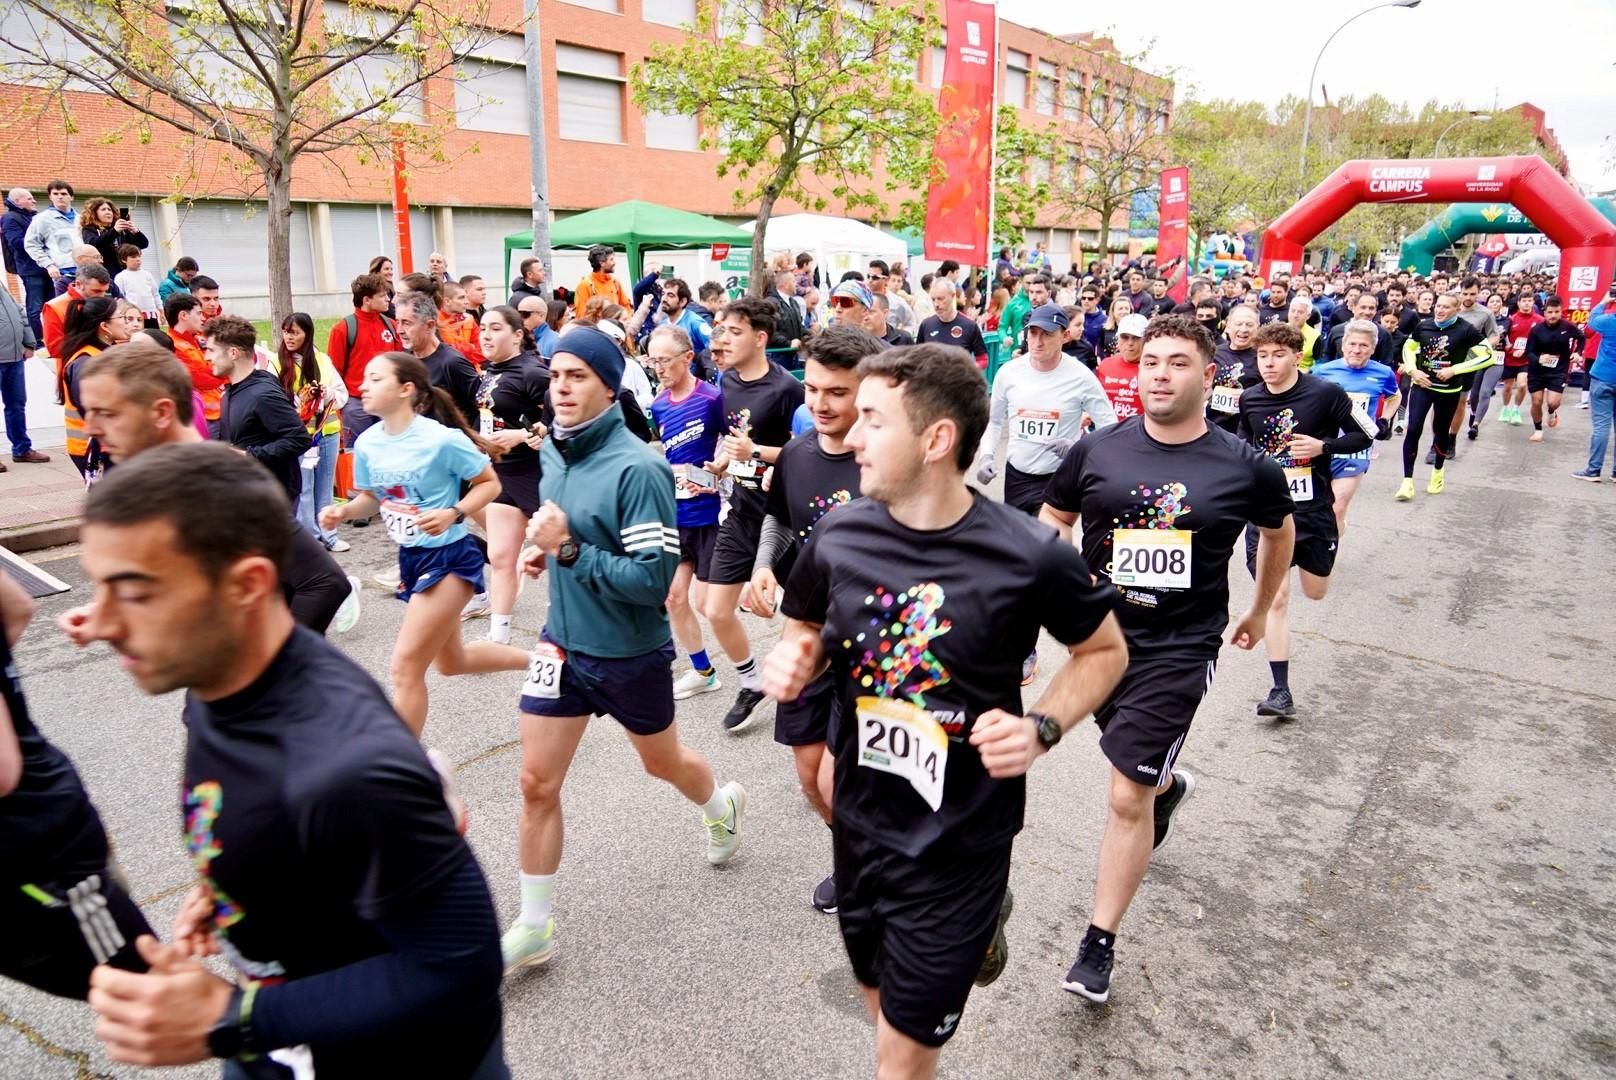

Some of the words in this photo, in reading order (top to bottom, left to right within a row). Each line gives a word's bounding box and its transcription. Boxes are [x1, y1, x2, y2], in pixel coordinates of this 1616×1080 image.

[1371, 167, 1430, 179] CARRERA
[1369, 180, 1423, 192] CAMPUS
[1515, 236, 1535, 245] LA
[1486, 243, 1504, 252] LR
[1019, 420, 1056, 436] 1617
[1118, 547, 1185, 574] 2008
[526, 660, 555, 687] 33
[865, 719, 938, 783] 2014
[1137, 764, 1158, 776] adidas
